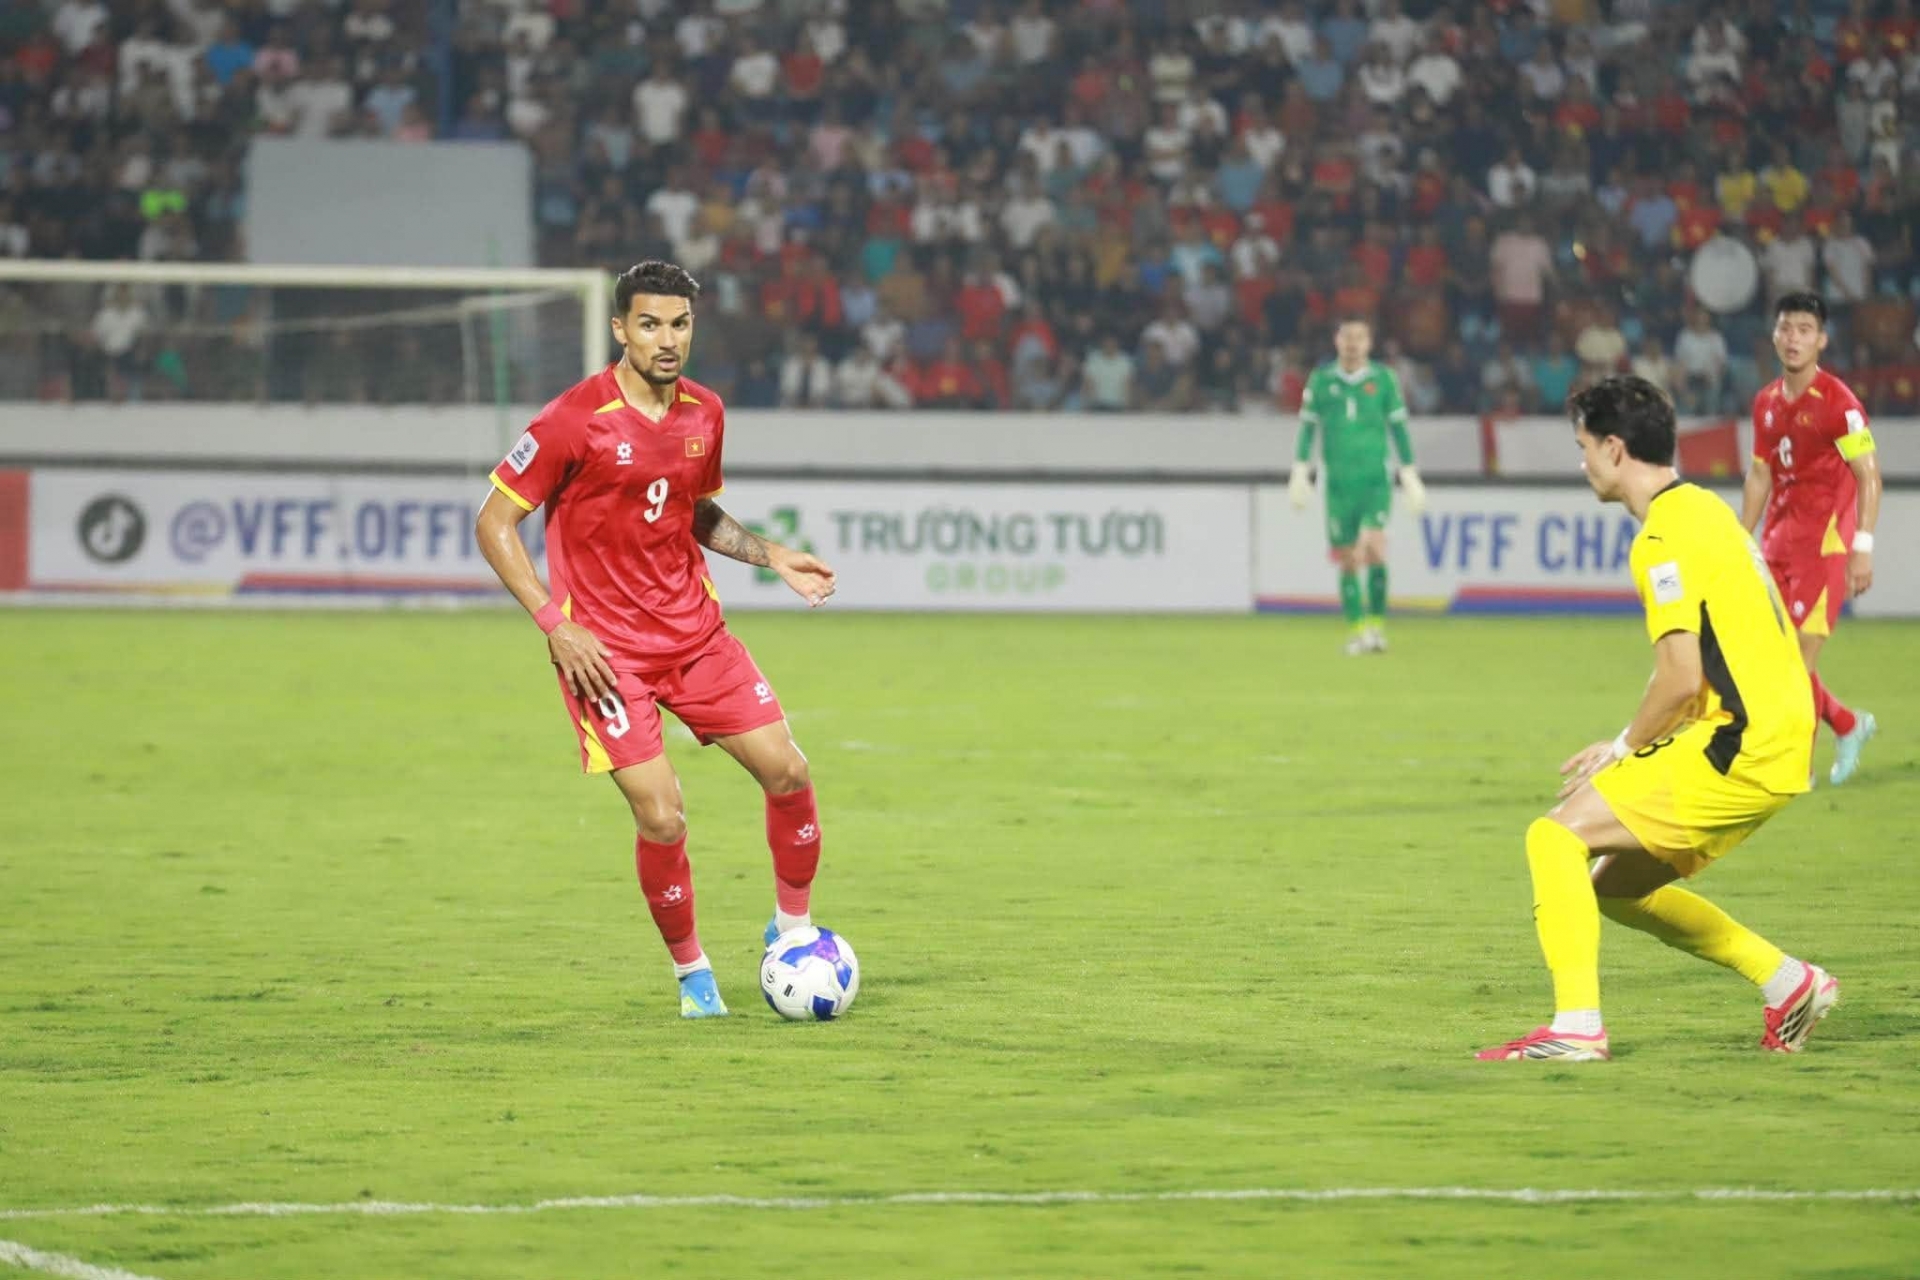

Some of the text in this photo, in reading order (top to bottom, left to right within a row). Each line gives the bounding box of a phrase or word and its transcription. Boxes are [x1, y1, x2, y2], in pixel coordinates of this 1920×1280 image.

[643, 477, 669, 523] 9
[1420, 511, 1517, 569] VFF
[925, 561, 1066, 592] GROUP
[599, 691, 630, 739] 9
